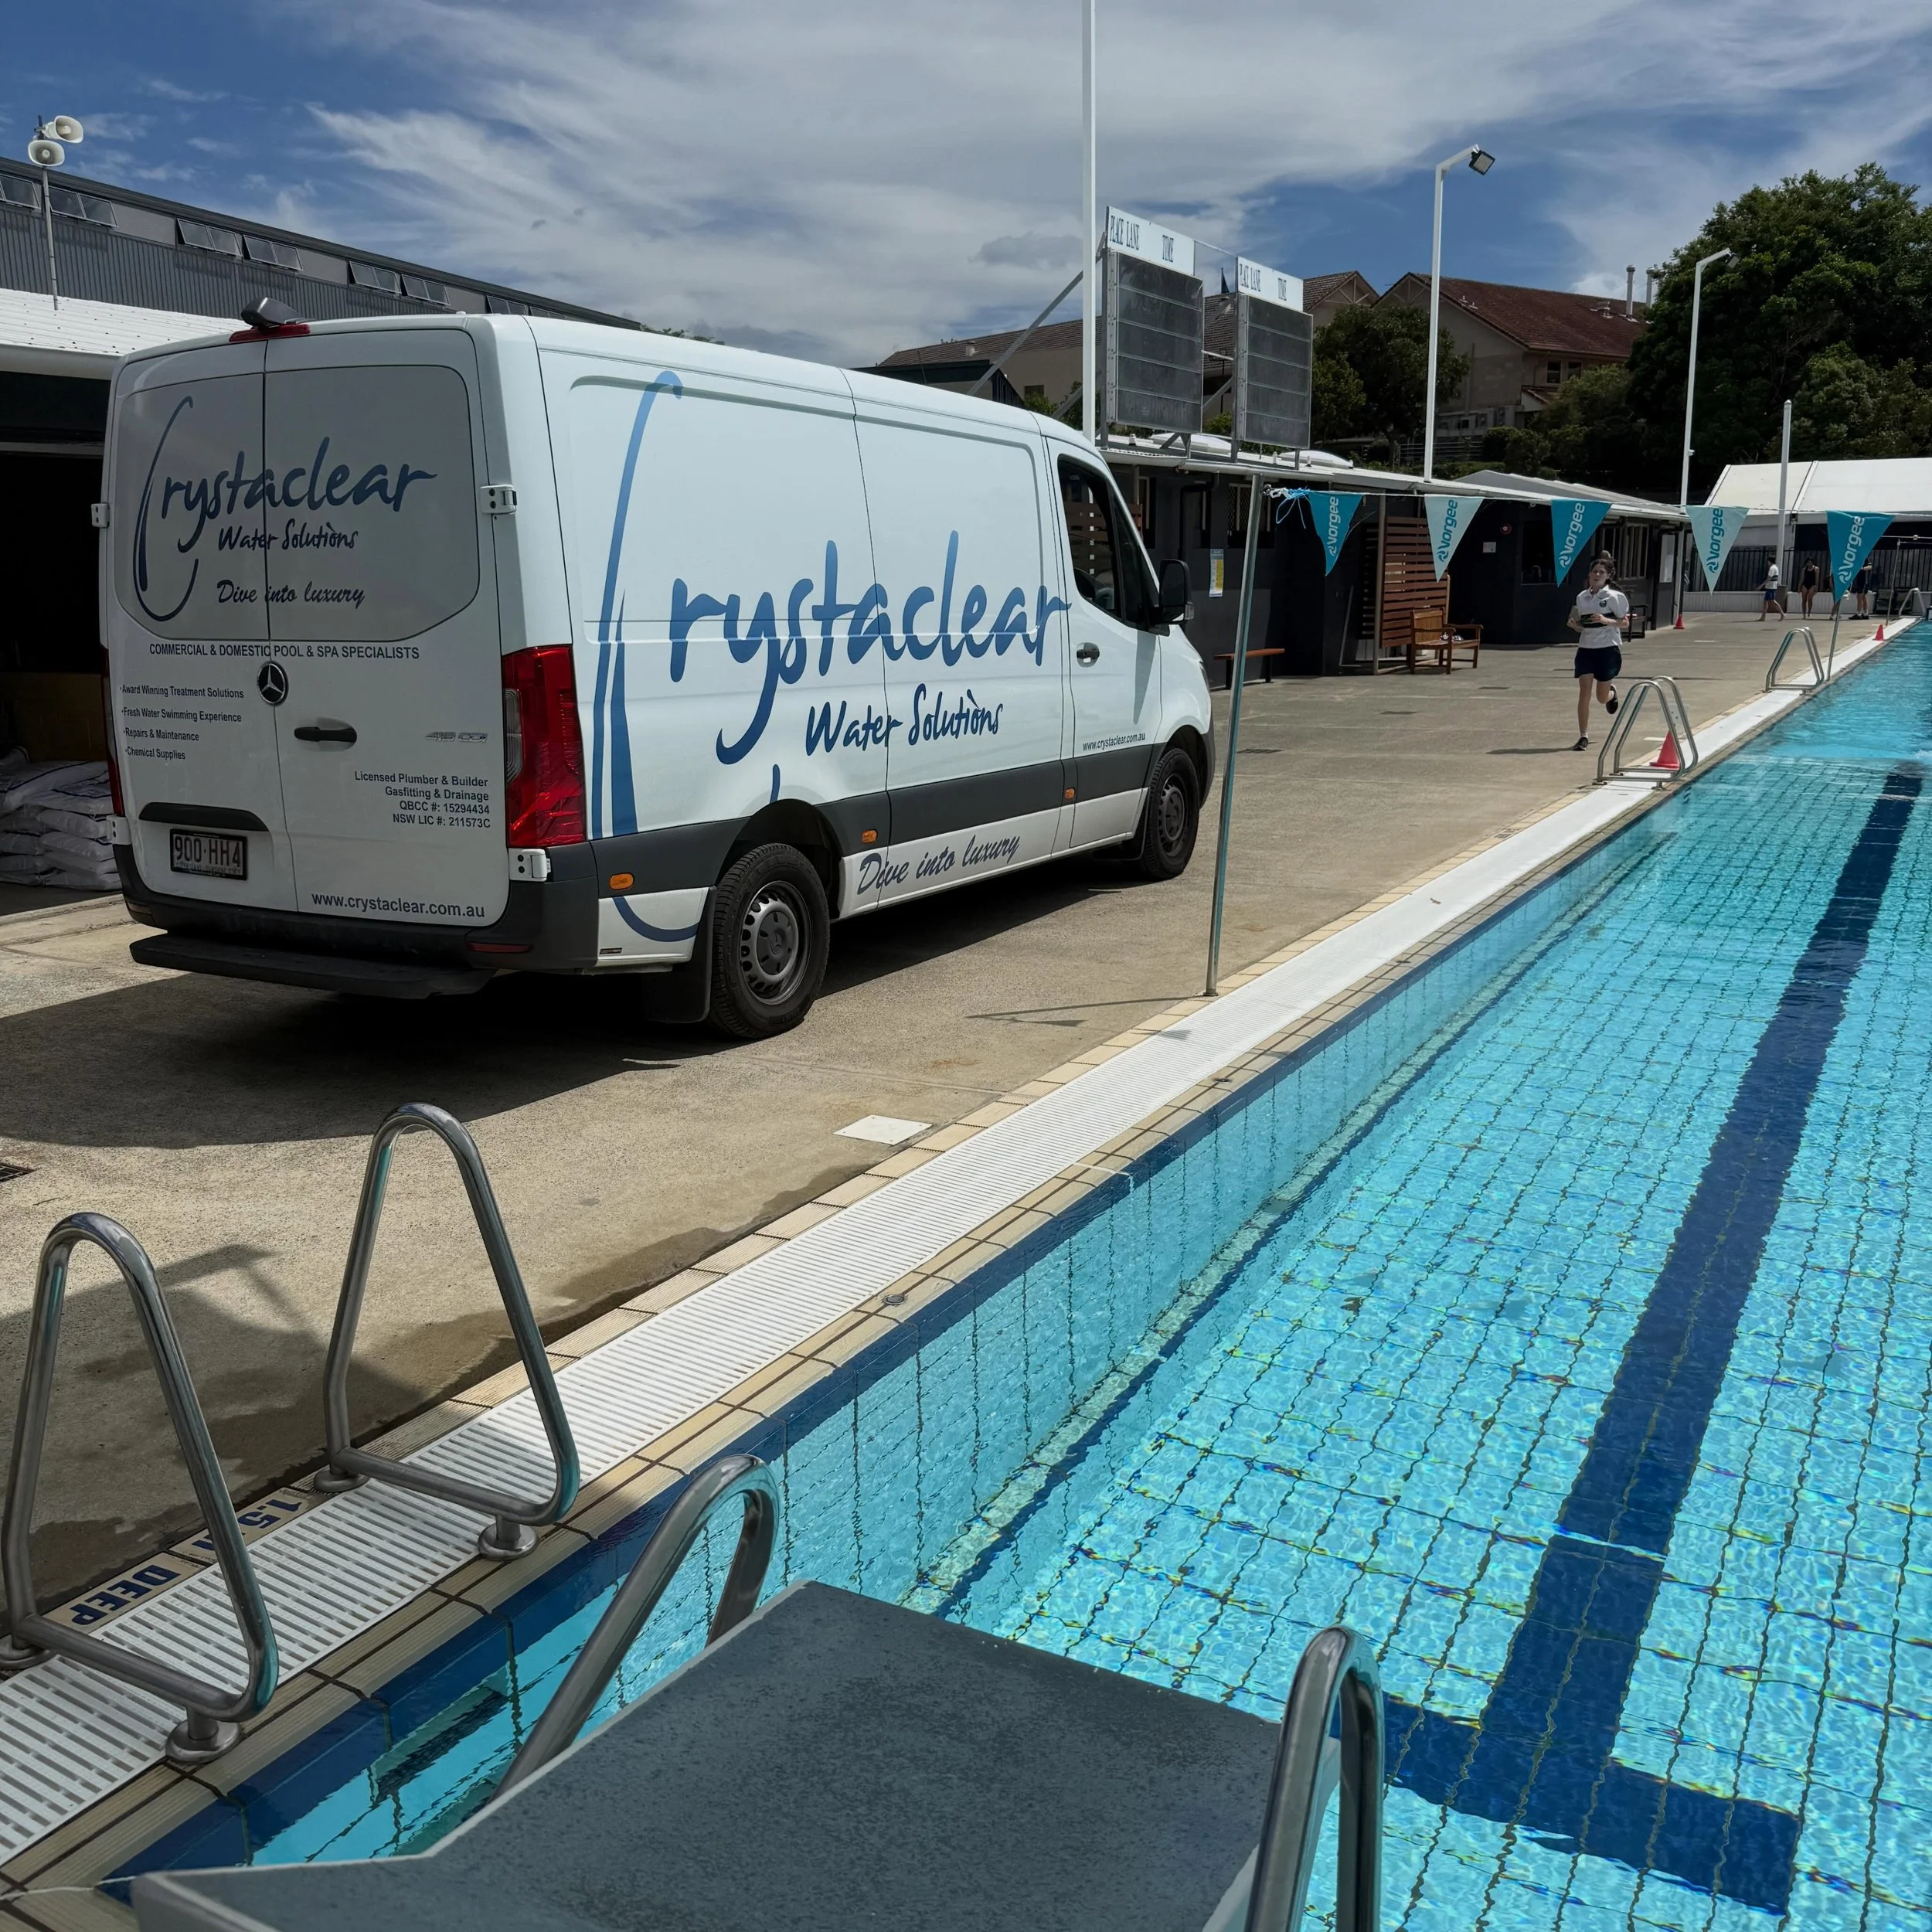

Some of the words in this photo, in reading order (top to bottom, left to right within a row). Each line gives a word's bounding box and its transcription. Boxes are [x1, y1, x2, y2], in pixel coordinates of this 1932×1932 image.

[1126, 221, 1139, 250] LANE
[1162, 234, 1174, 263] TIME
[218, 525, 279, 551] Water
[217, 579, 257, 604] Dive
[264, 584, 298, 604] into
[304, 580, 366, 609] luxury
[149, 643, 208, 656] COMMERCIAL
[210, 645, 216, 656] &
[219, 645, 270, 657] DOMESTIC
[274, 645, 303, 657] POOL
[307, 646, 314, 657] &
[317, 646, 338, 658] SPA
[342, 646, 420, 658] SPECIALISTS
[141, 685, 168, 697] Winning
[170, 686, 206, 697] Treatment
[207, 688, 244, 698] Solutions
[141, 708, 159, 718] Water
[162, 709, 198, 722] Swimming
[199, 711, 241, 723] Experience
[150, 729, 155, 738] &
[156, 730, 199, 741] Maintenance
[805, 700, 903, 757] Water
[1083, 733, 1145, 751] www.crystaclear.com.au
[156, 748, 185, 760] Supplies
[355, 771, 396, 782] Licensed
[399, 773, 438, 784] Plumber
[441, 775, 449, 785] &
[452, 776, 488, 787] Builder
[385, 786, 430, 800] Gasfitting
[434, 789, 441, 798] &
[444, 789, 489, 802] Drainage
[400, 801, 428, 811] QBCC
[444, 803, 490, 815] 15294434
[393, 814, 416, 824] NSW
[418, 815, 434, 825] LIC
[449, 817, 491, 828] 211573C
[856, 852, 910, 894] Dive
[916, 846, 955, 879] into
[962, 834, 1021, 867] luxury
[311, 893, 485, 917] www.crystaclear.com.au
[70, 1564, 181, 1625] DEEP
